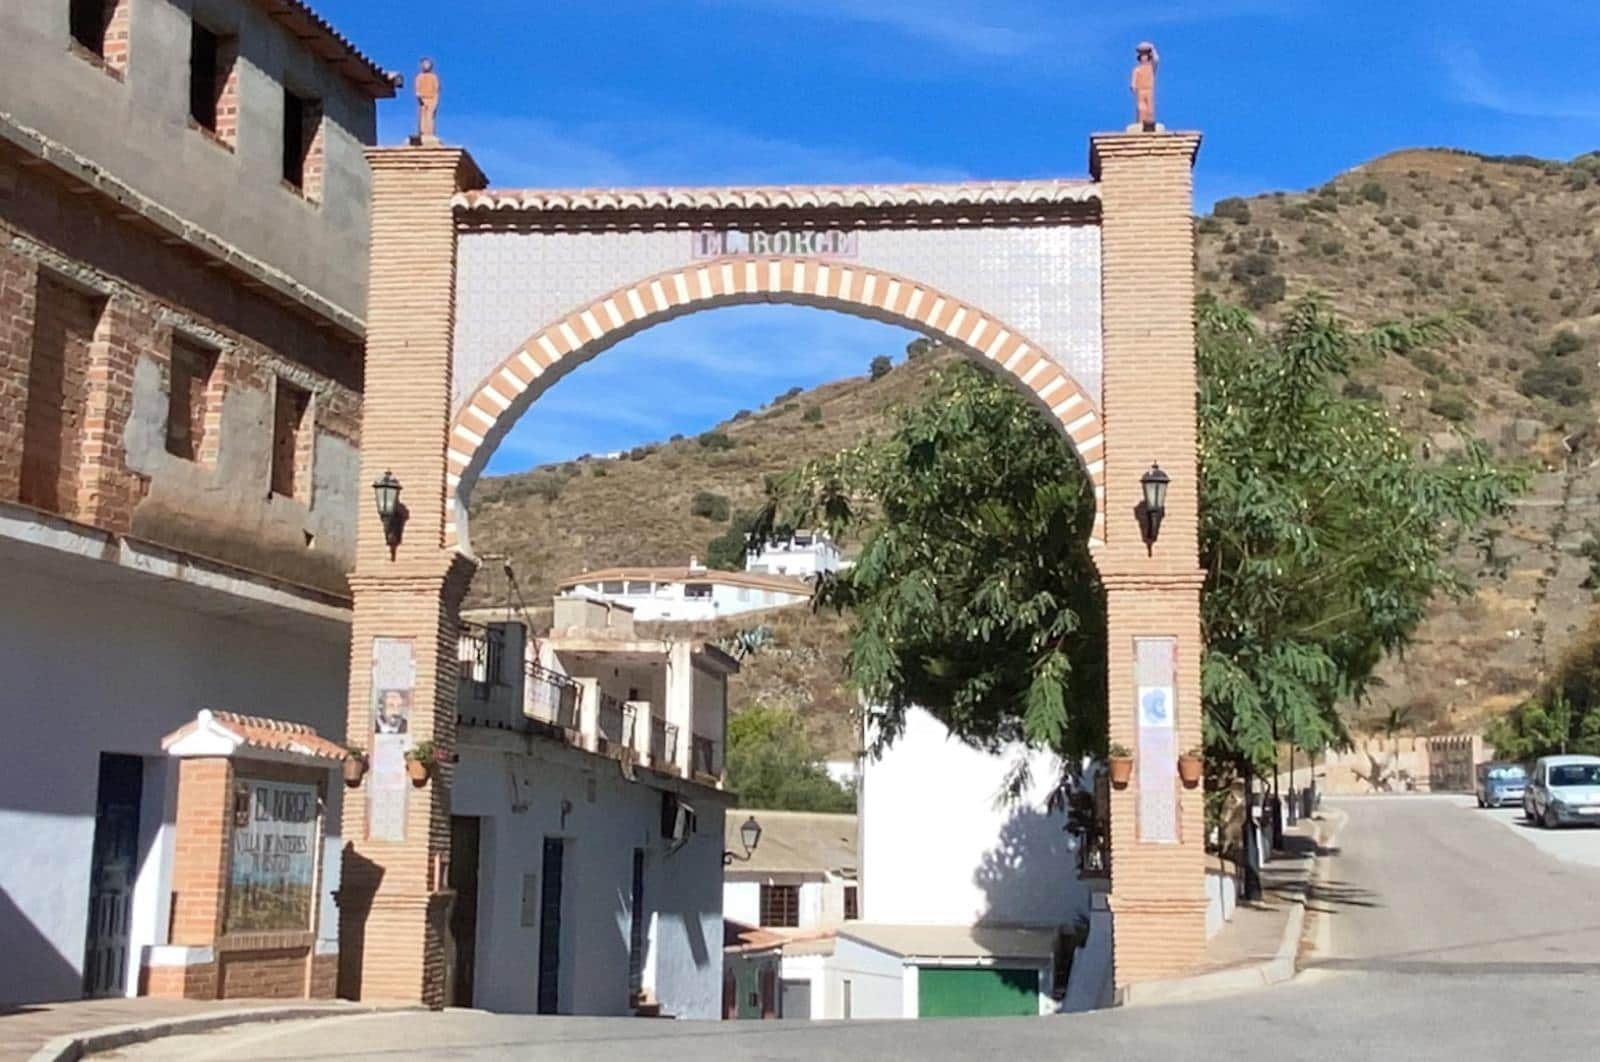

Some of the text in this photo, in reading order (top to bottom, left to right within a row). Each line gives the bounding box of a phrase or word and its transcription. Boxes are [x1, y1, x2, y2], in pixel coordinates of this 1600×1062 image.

[701, 231, 850, 255] EL BORGE
[255, 787, 268, 821] EL
